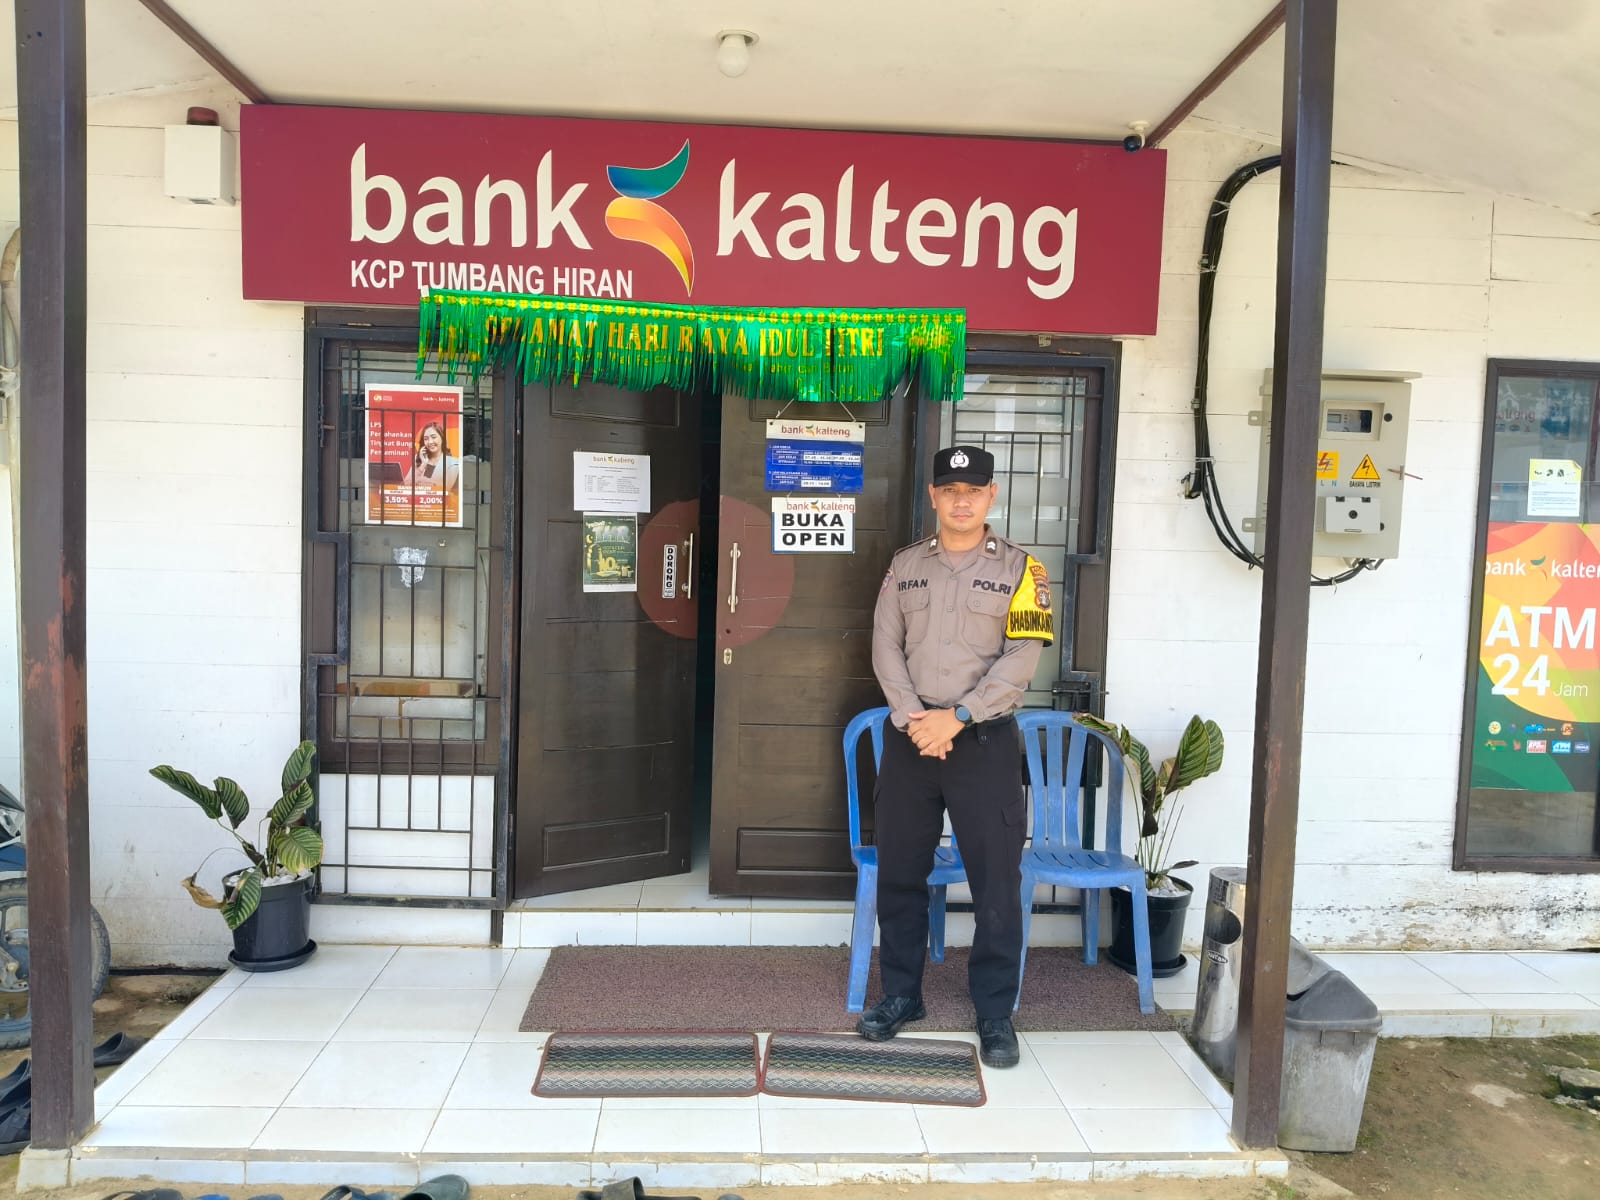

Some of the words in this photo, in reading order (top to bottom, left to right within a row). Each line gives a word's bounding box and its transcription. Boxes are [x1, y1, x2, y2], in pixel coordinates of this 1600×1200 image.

[350, 142, 593, 250] bank
[716, 158, 1078, 299] kalteng
[351, 259, 404, 289] KCP
[412, 261, 544, 295] TUMBANG
[553, 267, 632, 298] HIRAN
[608, 321, 669, 351] HARI
[678, 325, 748, 356] RAYA
[760, 328, 814, 357] IDUL
[781, 425, 803, 434] bank
[816, 426, 850, 437] kalteng
[782, 513, 844, 527] BUKA
[787, 501, 809, 511] bank
[821, 501, 855, 513] kalteng
[782, 532, 845, 546] OPEN
[666, 547, 674, 588] DORONG
[898, 578, 928, 592] IRFAN
[972, 578, 1011, 595] POLRI
[1484, 605, 1597, 649] ATM
[1491, 653, 1550, 697] 24
[1552, 682, 1588, 697] Jam
